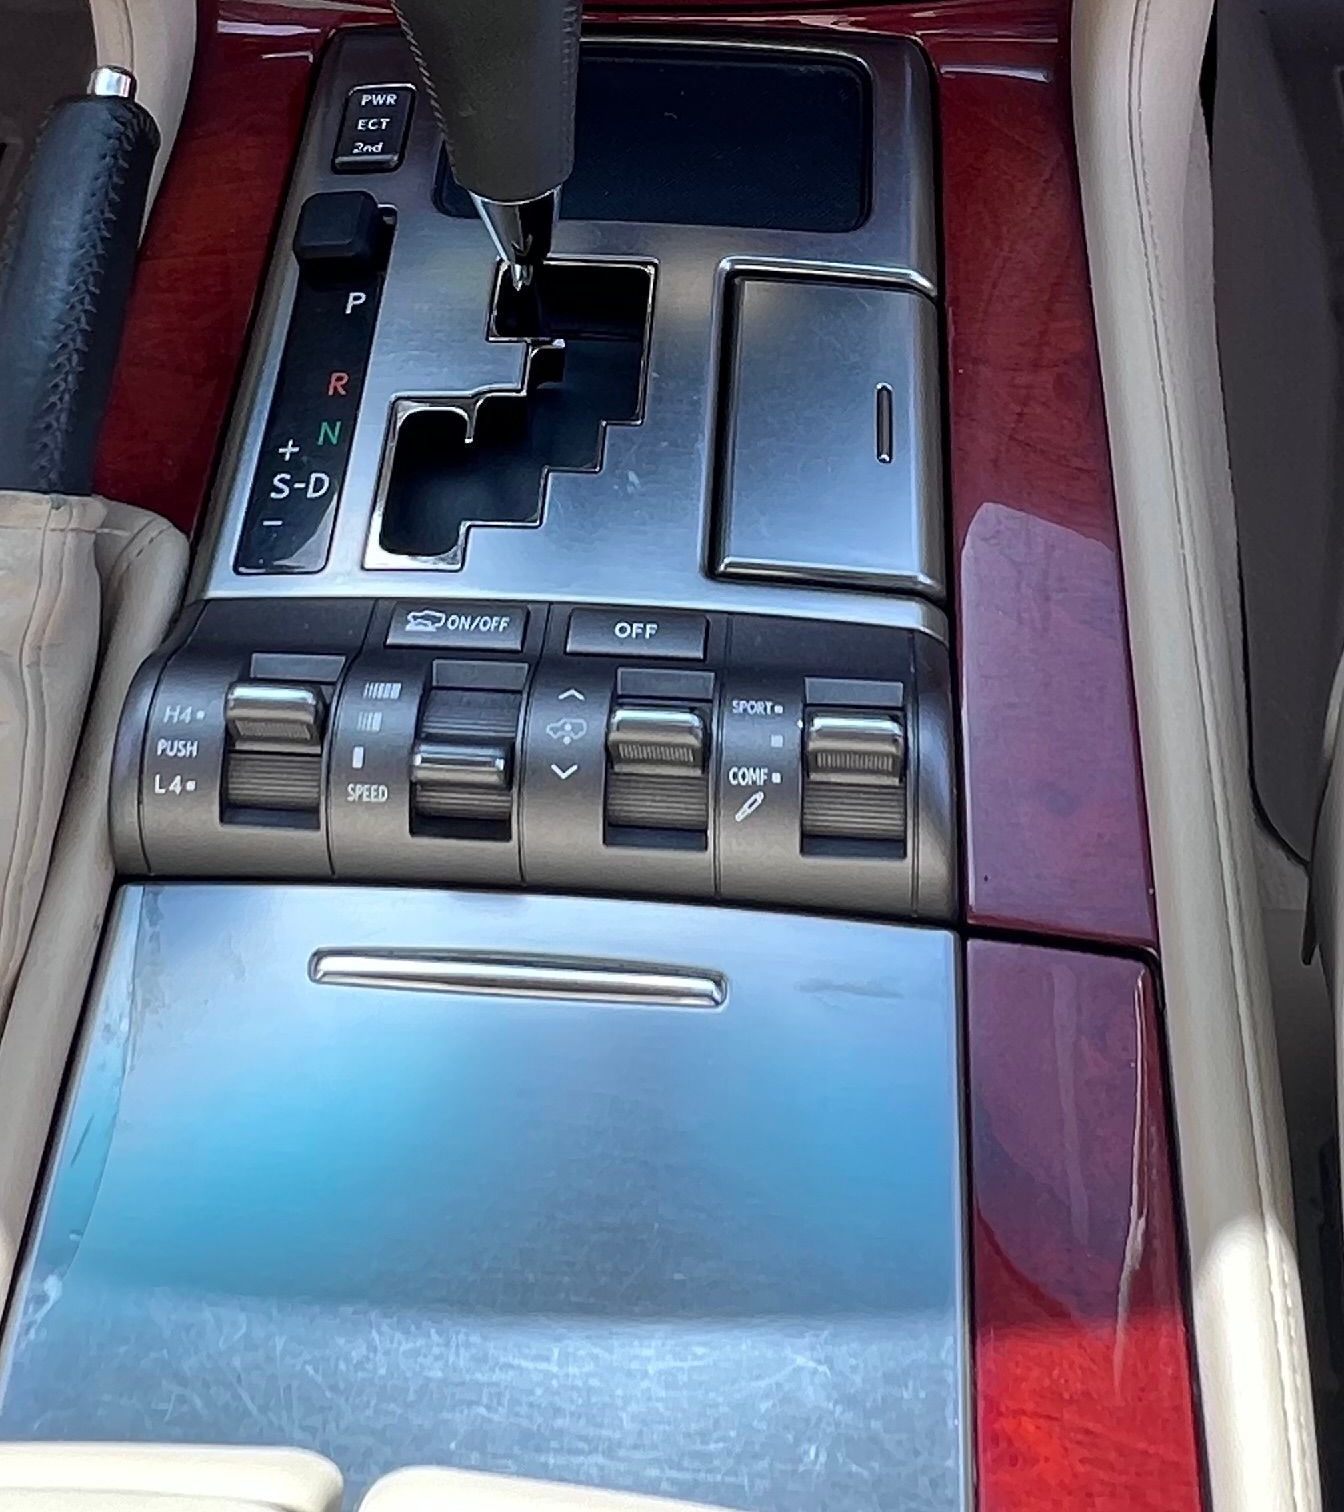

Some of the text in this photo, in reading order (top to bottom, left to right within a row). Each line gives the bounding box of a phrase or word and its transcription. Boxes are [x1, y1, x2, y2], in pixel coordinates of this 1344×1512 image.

[361, 94, 397, 106] PWR
[357, 118, 390, 130] ECT
[352, 142, 384, 153] 2nd
[345, 292, 366, 314] P
[328, 372, 349, 396] R
[317, 421, 341, 445] N
[447, 613, 509, 632] ON/OFF
[615, 622, 657, 639] OFF
[164, 706, 192, 724] H4
[732, 700, 772, 715] SPORT
[157, 740, 198, 757] PUSH
[154, 775, 182, 795] L4
[729, 767, 768, 786] COMF
[347, 784, 388, 802] SPEED
